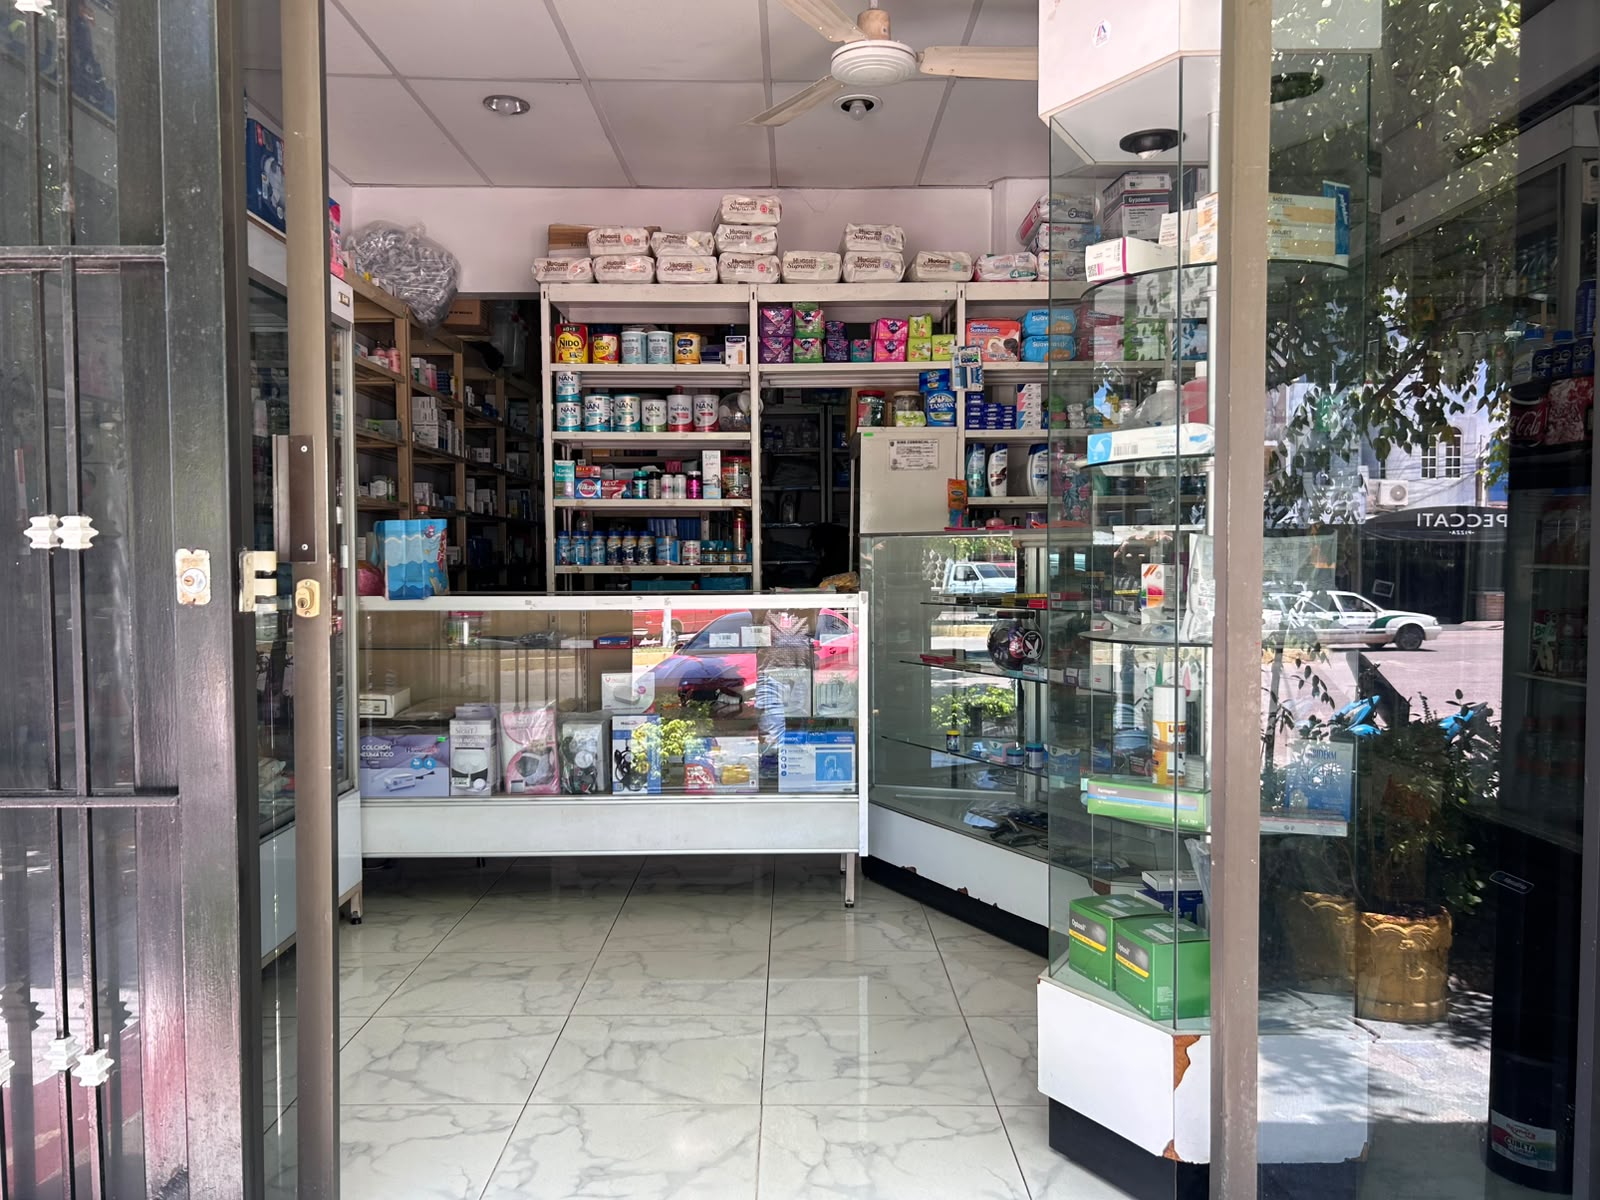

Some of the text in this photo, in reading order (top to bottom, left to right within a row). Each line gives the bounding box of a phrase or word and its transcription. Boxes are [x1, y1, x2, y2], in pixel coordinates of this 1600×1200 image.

[1012, 270, 1018, 278] 4
[560, 339, 580, 348] NIDO
[361, 743, 392, 751] COLCHÓN
